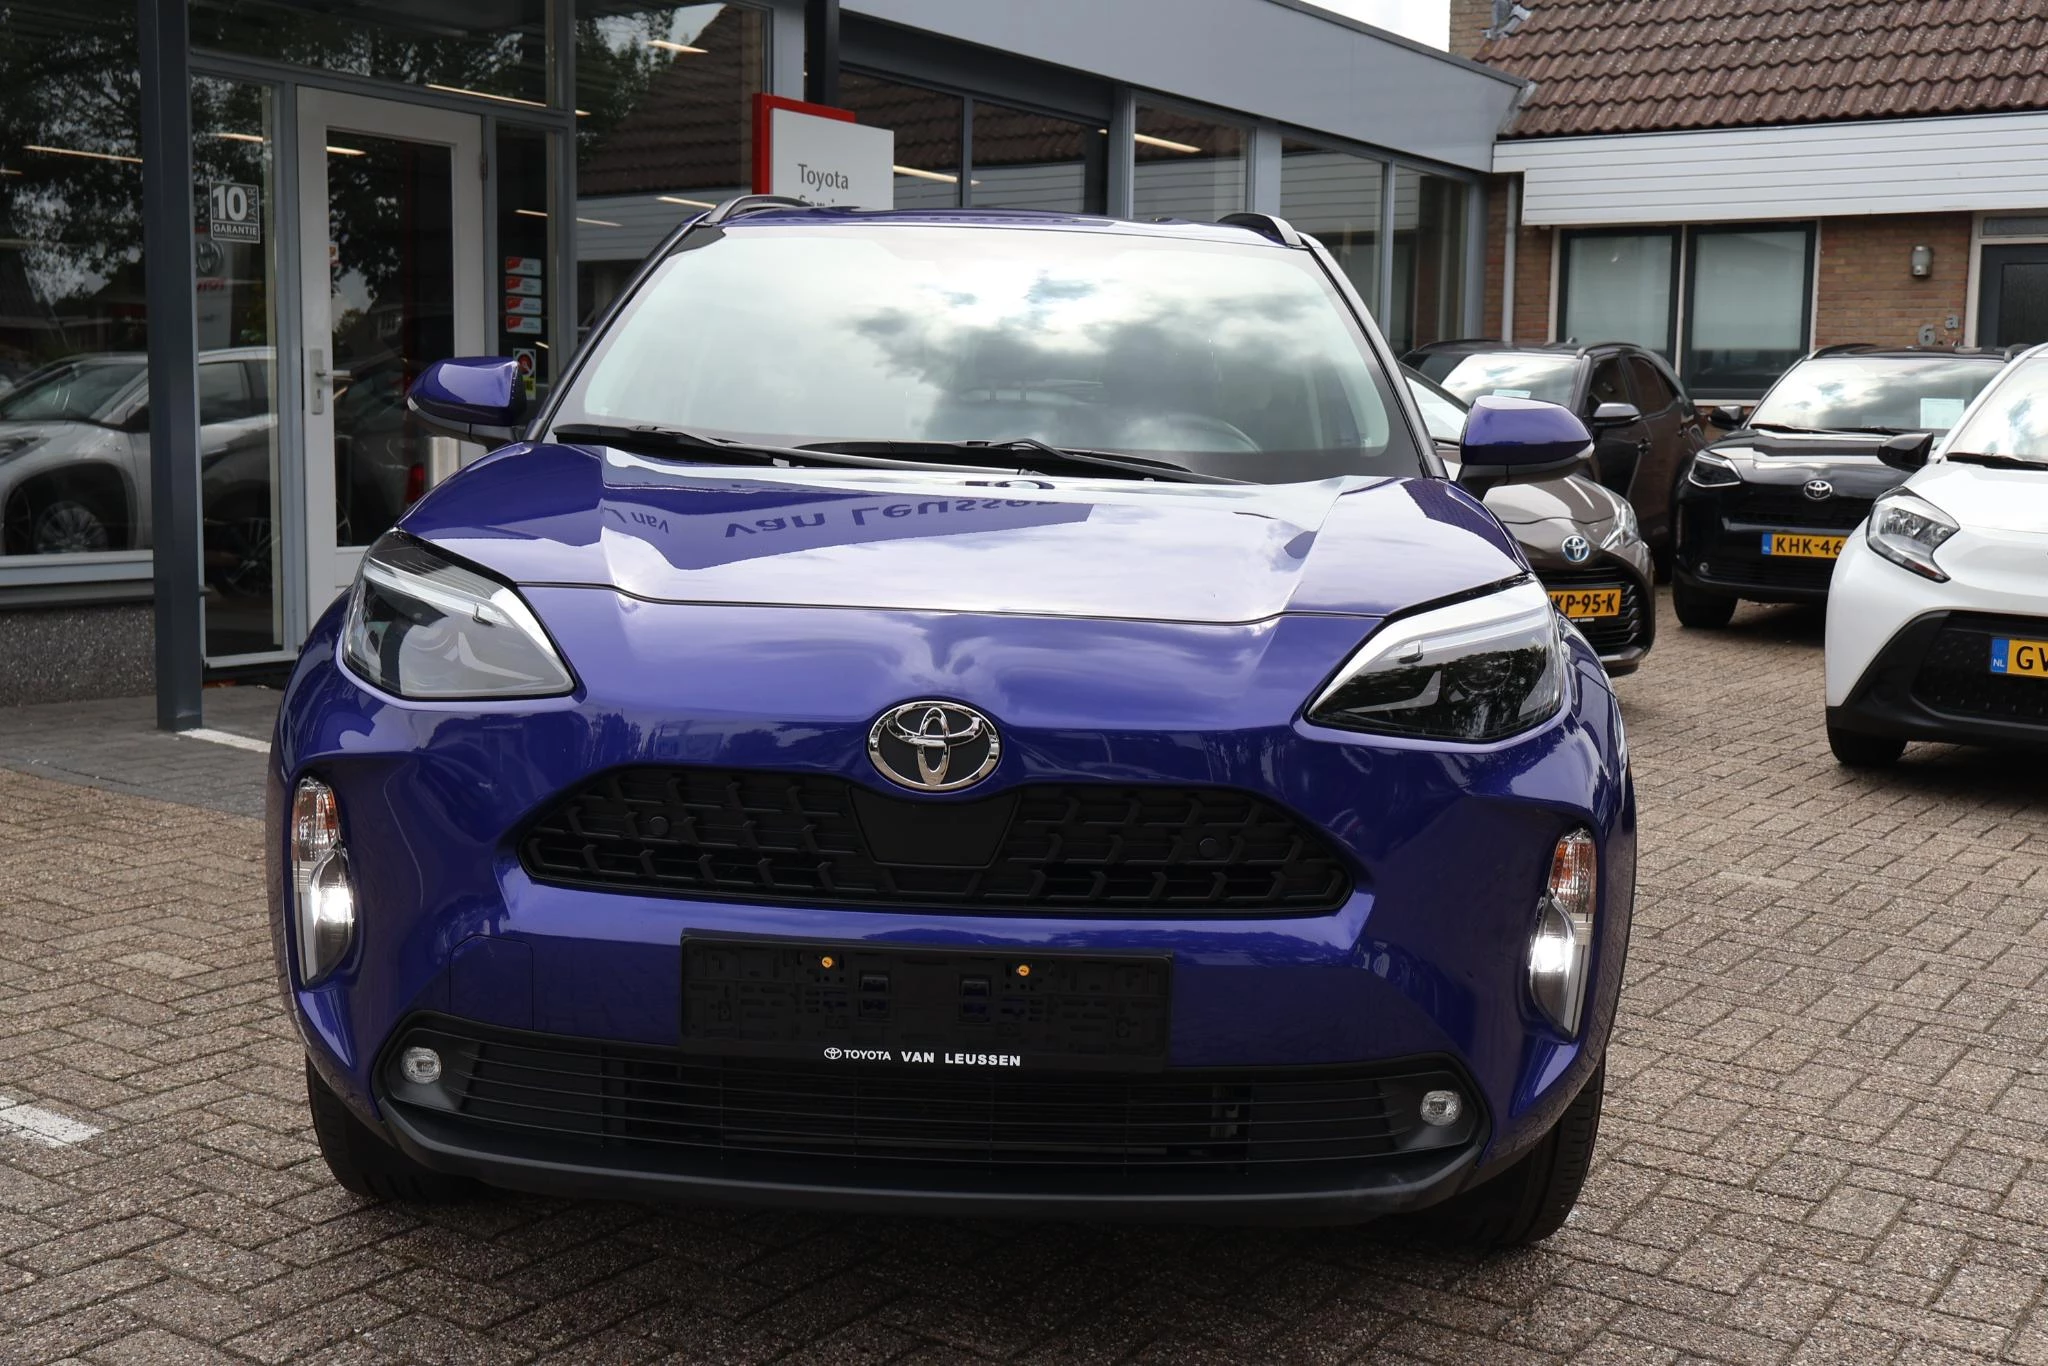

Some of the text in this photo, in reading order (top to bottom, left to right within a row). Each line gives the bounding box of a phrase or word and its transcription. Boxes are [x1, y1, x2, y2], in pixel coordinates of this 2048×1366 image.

[797, 163, 848, 192] Toyota
[213, 185, 248, 220] 10
[213, 224, 257, 236] GARANTIE
[1993, 658, 2005, 668] NL
[844, 1049, 1021, 1066] TOYOTA VAN LEUSSEN
